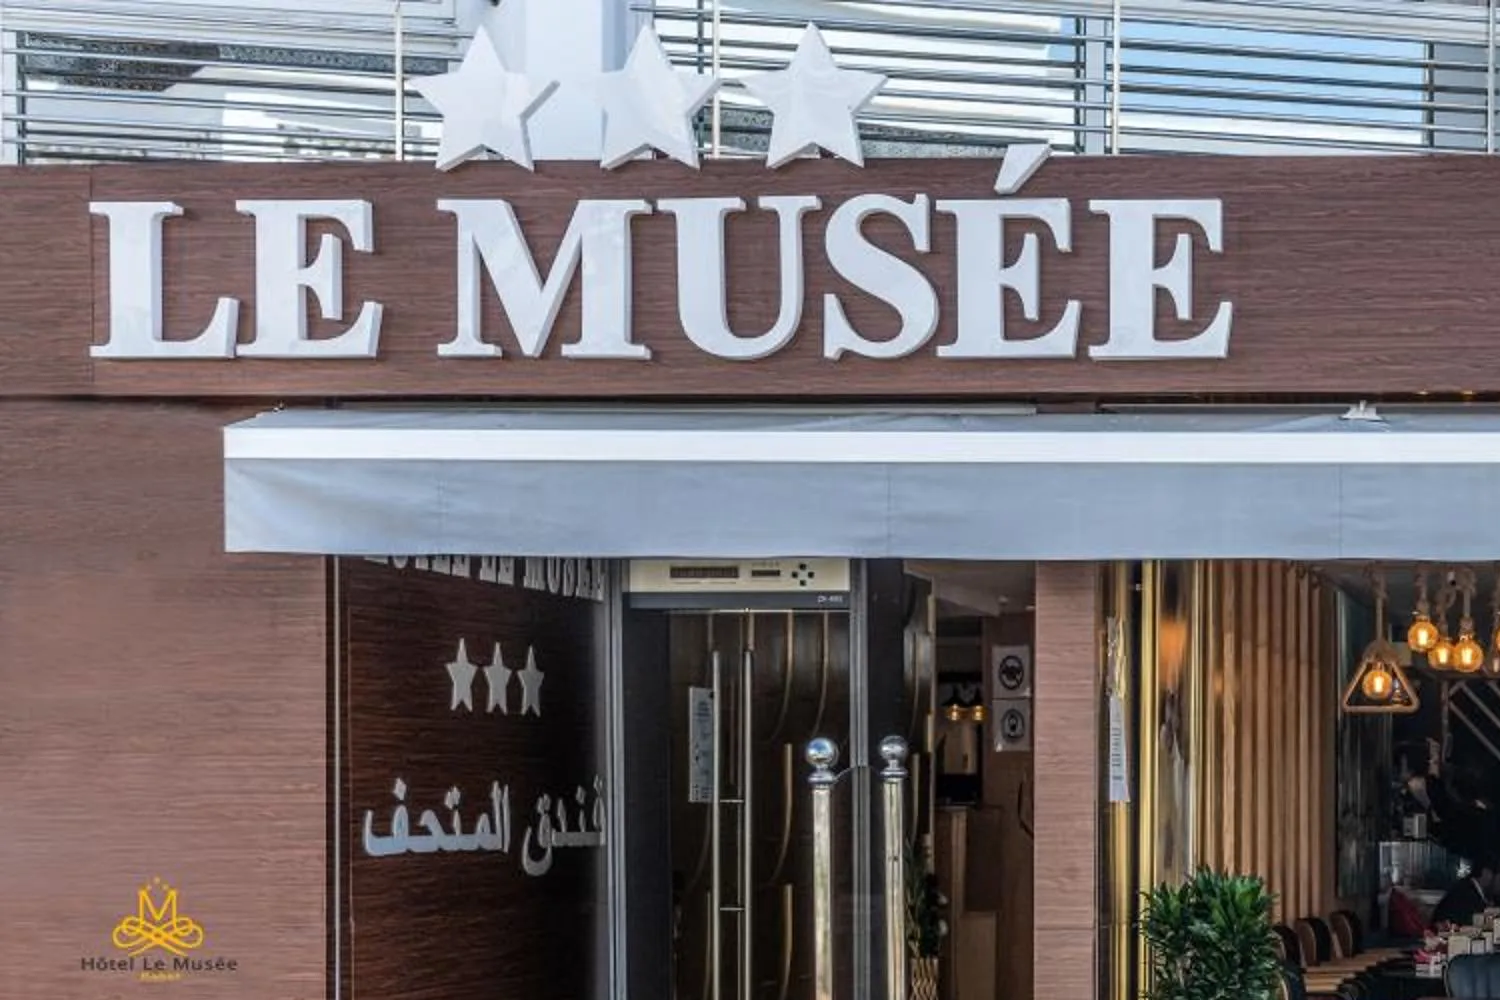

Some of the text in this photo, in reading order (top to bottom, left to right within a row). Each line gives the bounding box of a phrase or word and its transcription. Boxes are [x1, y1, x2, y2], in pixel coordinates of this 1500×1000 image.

[89, 144, 1233, 361] LE MUSÉE
[363, 774, 606, 876] فندق المتحف
[80, 957, 238, 971] Hôtel Le Musée
